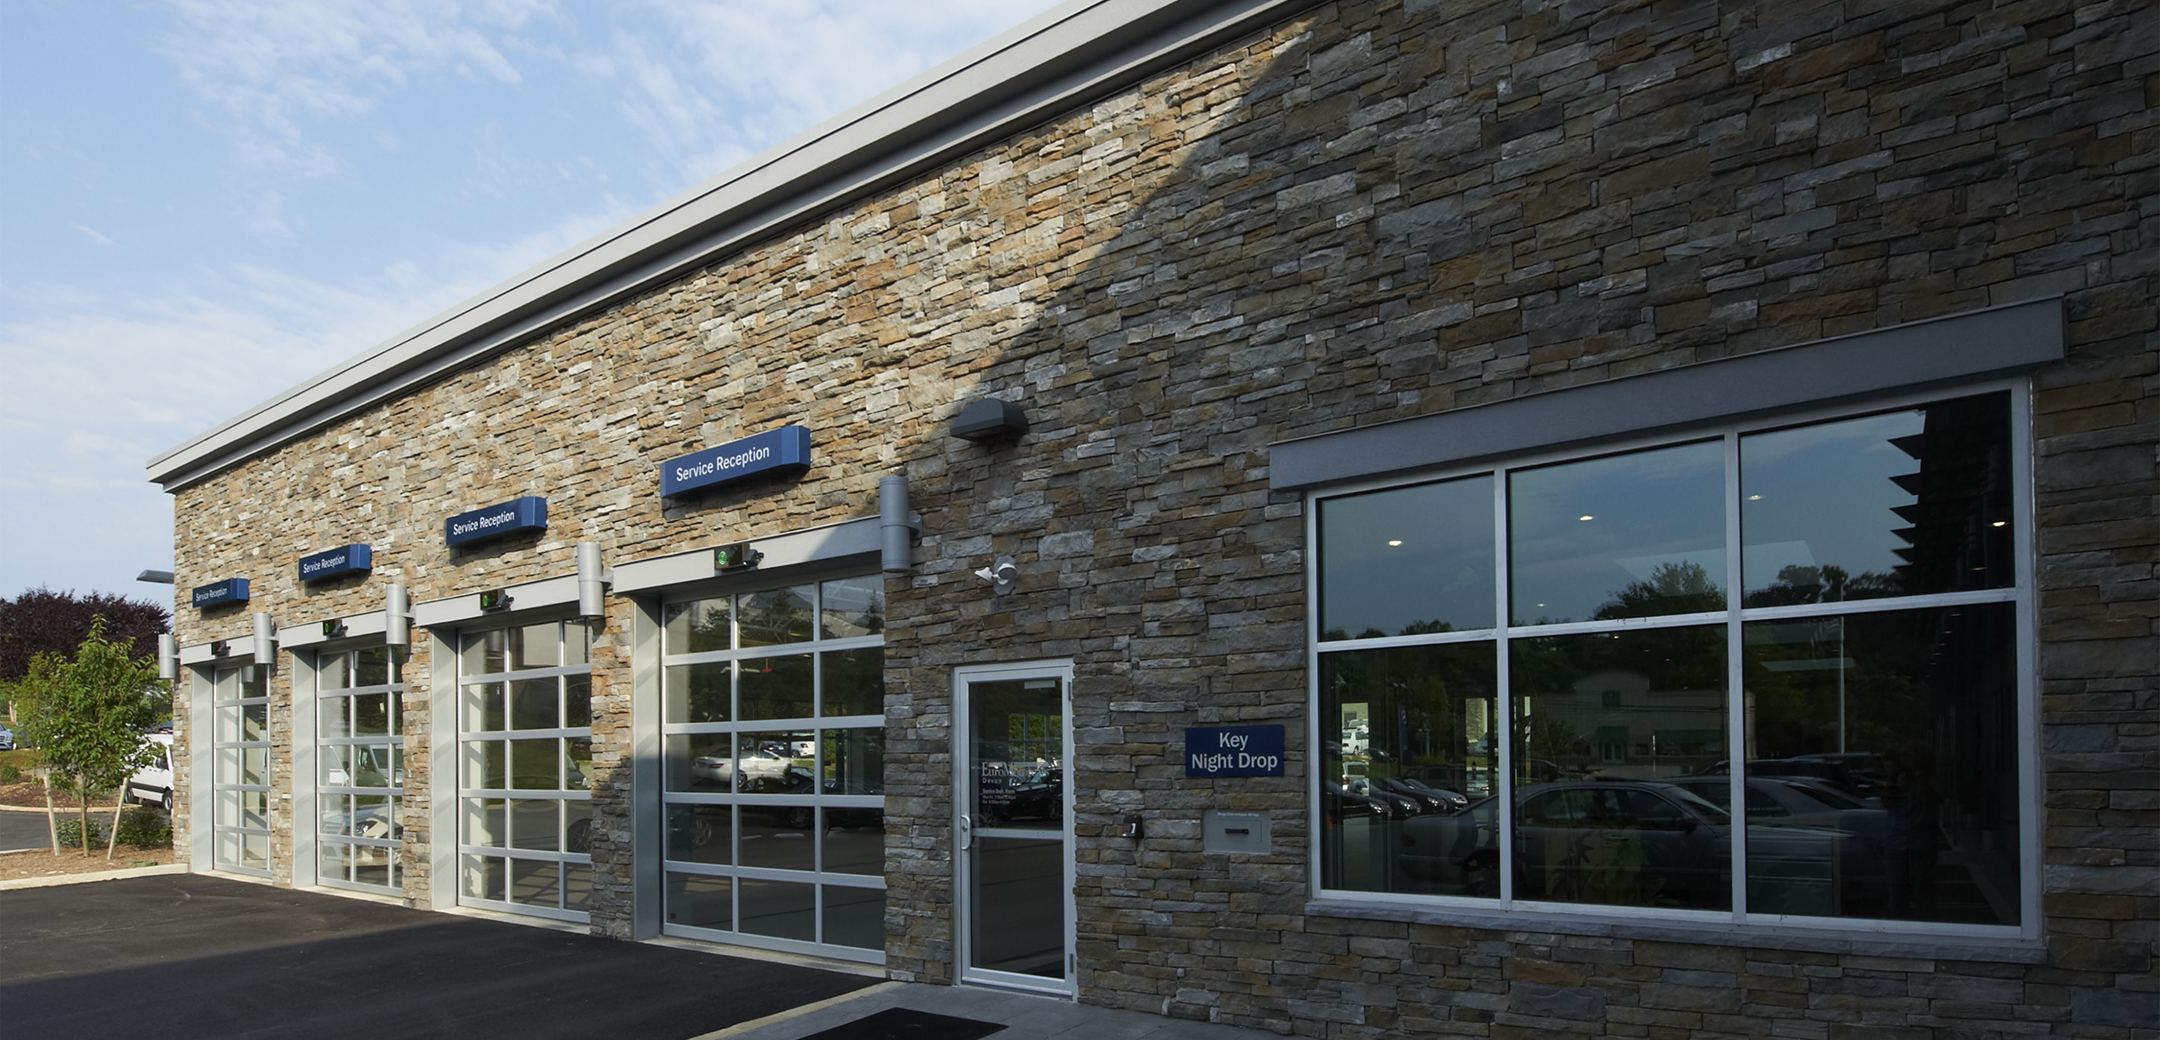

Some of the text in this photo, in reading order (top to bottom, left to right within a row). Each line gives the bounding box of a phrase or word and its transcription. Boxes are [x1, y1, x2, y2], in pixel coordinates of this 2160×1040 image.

[676, 446, 770, 482] Service Reception
[453, 511, 515, 536] Service Reception
[303, 555, 345, 574] Service Reception
[1219, 732, 1248, 751] Key
[1192, 752, 1278, 772] Night Drop
